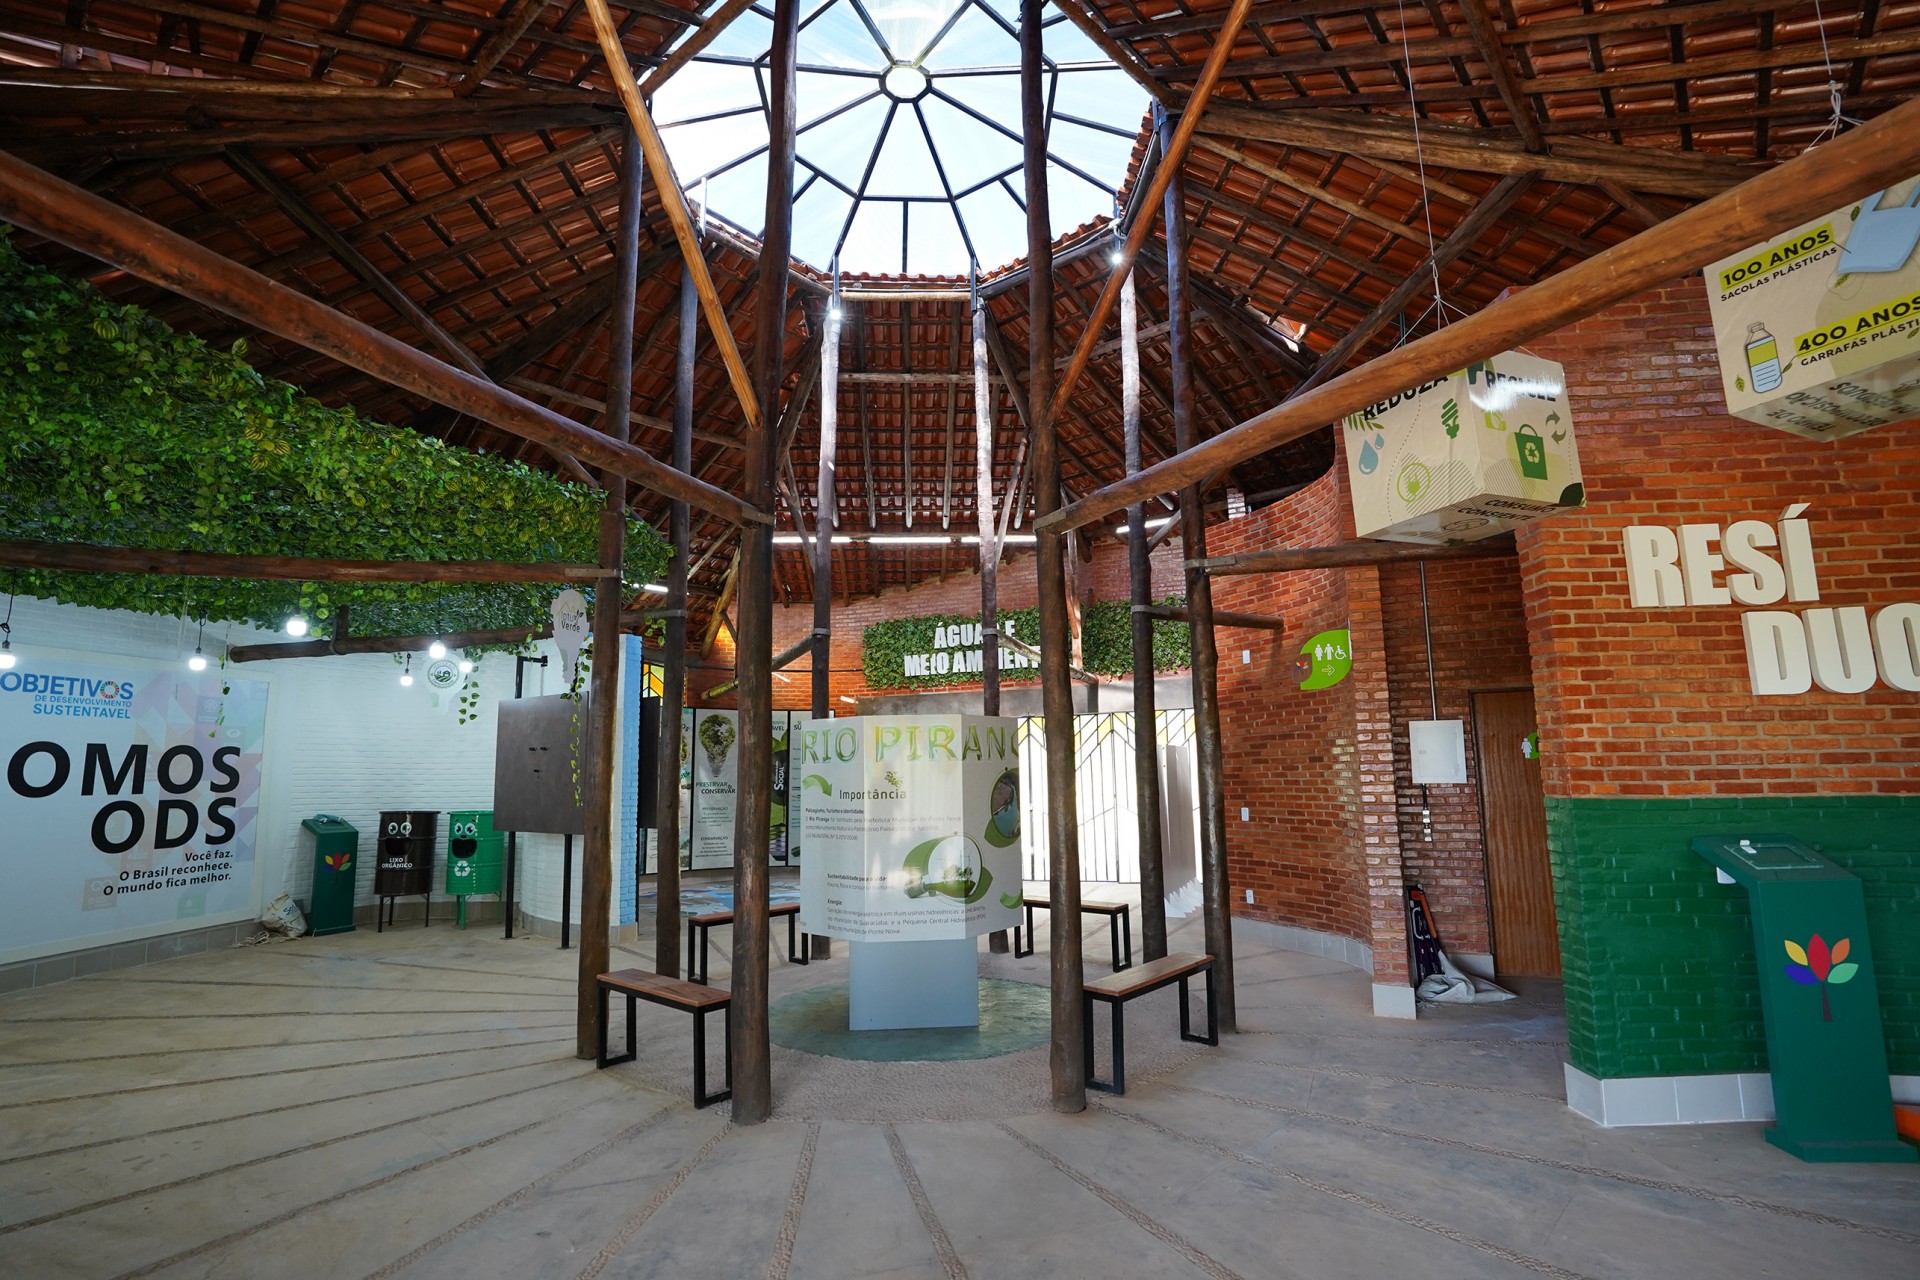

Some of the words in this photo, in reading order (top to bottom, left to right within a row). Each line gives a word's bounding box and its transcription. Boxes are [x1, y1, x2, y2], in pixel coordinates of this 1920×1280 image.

[1723, 261, 1762, 286] 100
[1770, 229, 1830, 266] ANOS
[1772, 246, 1838, 280] PLÁSTICAS
[1798, 325, 1847, 352] 400
[1856, 295, 1920, 333] ANOS
[1800, 337, 1868, 367] GARRAFAS
[1622, 502, 1820, 608] RESÍ
[934, 622, 1000, 649] ÁGUA
[952, 645, 1041, 673] AMIENT
[0, 672, 134, 700] OBJETIVOS
[35, 694, 47, 702] DE
[49, 695, 132, 708] DESENVOLVIMENTO
[802, 727, 857, 764] RIO
[7, 740, 241, 798] OMOS
[840, 788, 906, 801] Importância
[90, 796, 237, 854] ODS
[185, 850, 212, 862] Você
[214, 850, 234, 860] faz.
[103, 886, 113, 896] O
[117, 879, 162, 894] mundo
[166, 878, 187, 888] fica
[190, 872, 232, 885] melhor.
[119, 871, 130, 881] O
[133, 867, 168, 880] Brasil
[171, 862, 232, 875] reconhece.
